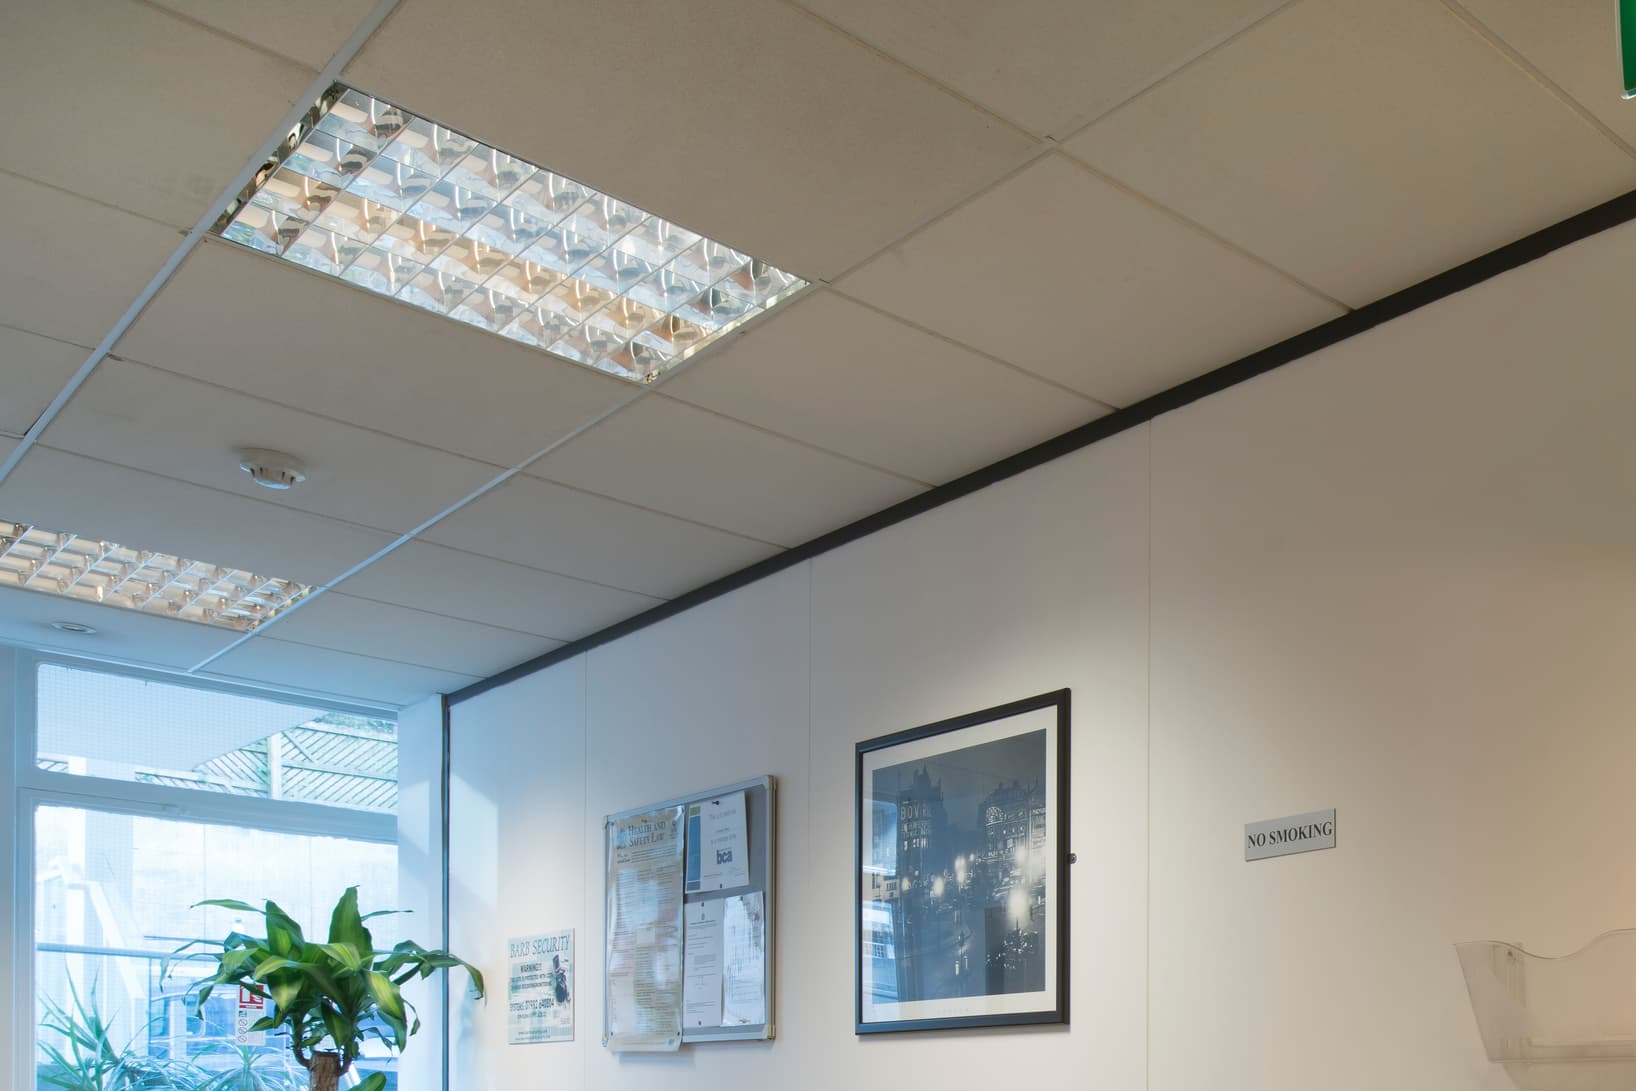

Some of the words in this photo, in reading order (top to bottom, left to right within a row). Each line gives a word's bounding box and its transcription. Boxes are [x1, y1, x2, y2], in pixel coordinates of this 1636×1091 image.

[628, 824, 651, 835] HEALTH
[1247, 832, 1266, 849] NO
[1268, 821, 1333, 846] SMOKING
[630, 835, 650, 847] SAFETY
[716, 849, 733, 864] bca
[531, 935, 570, 955] SECURITY
